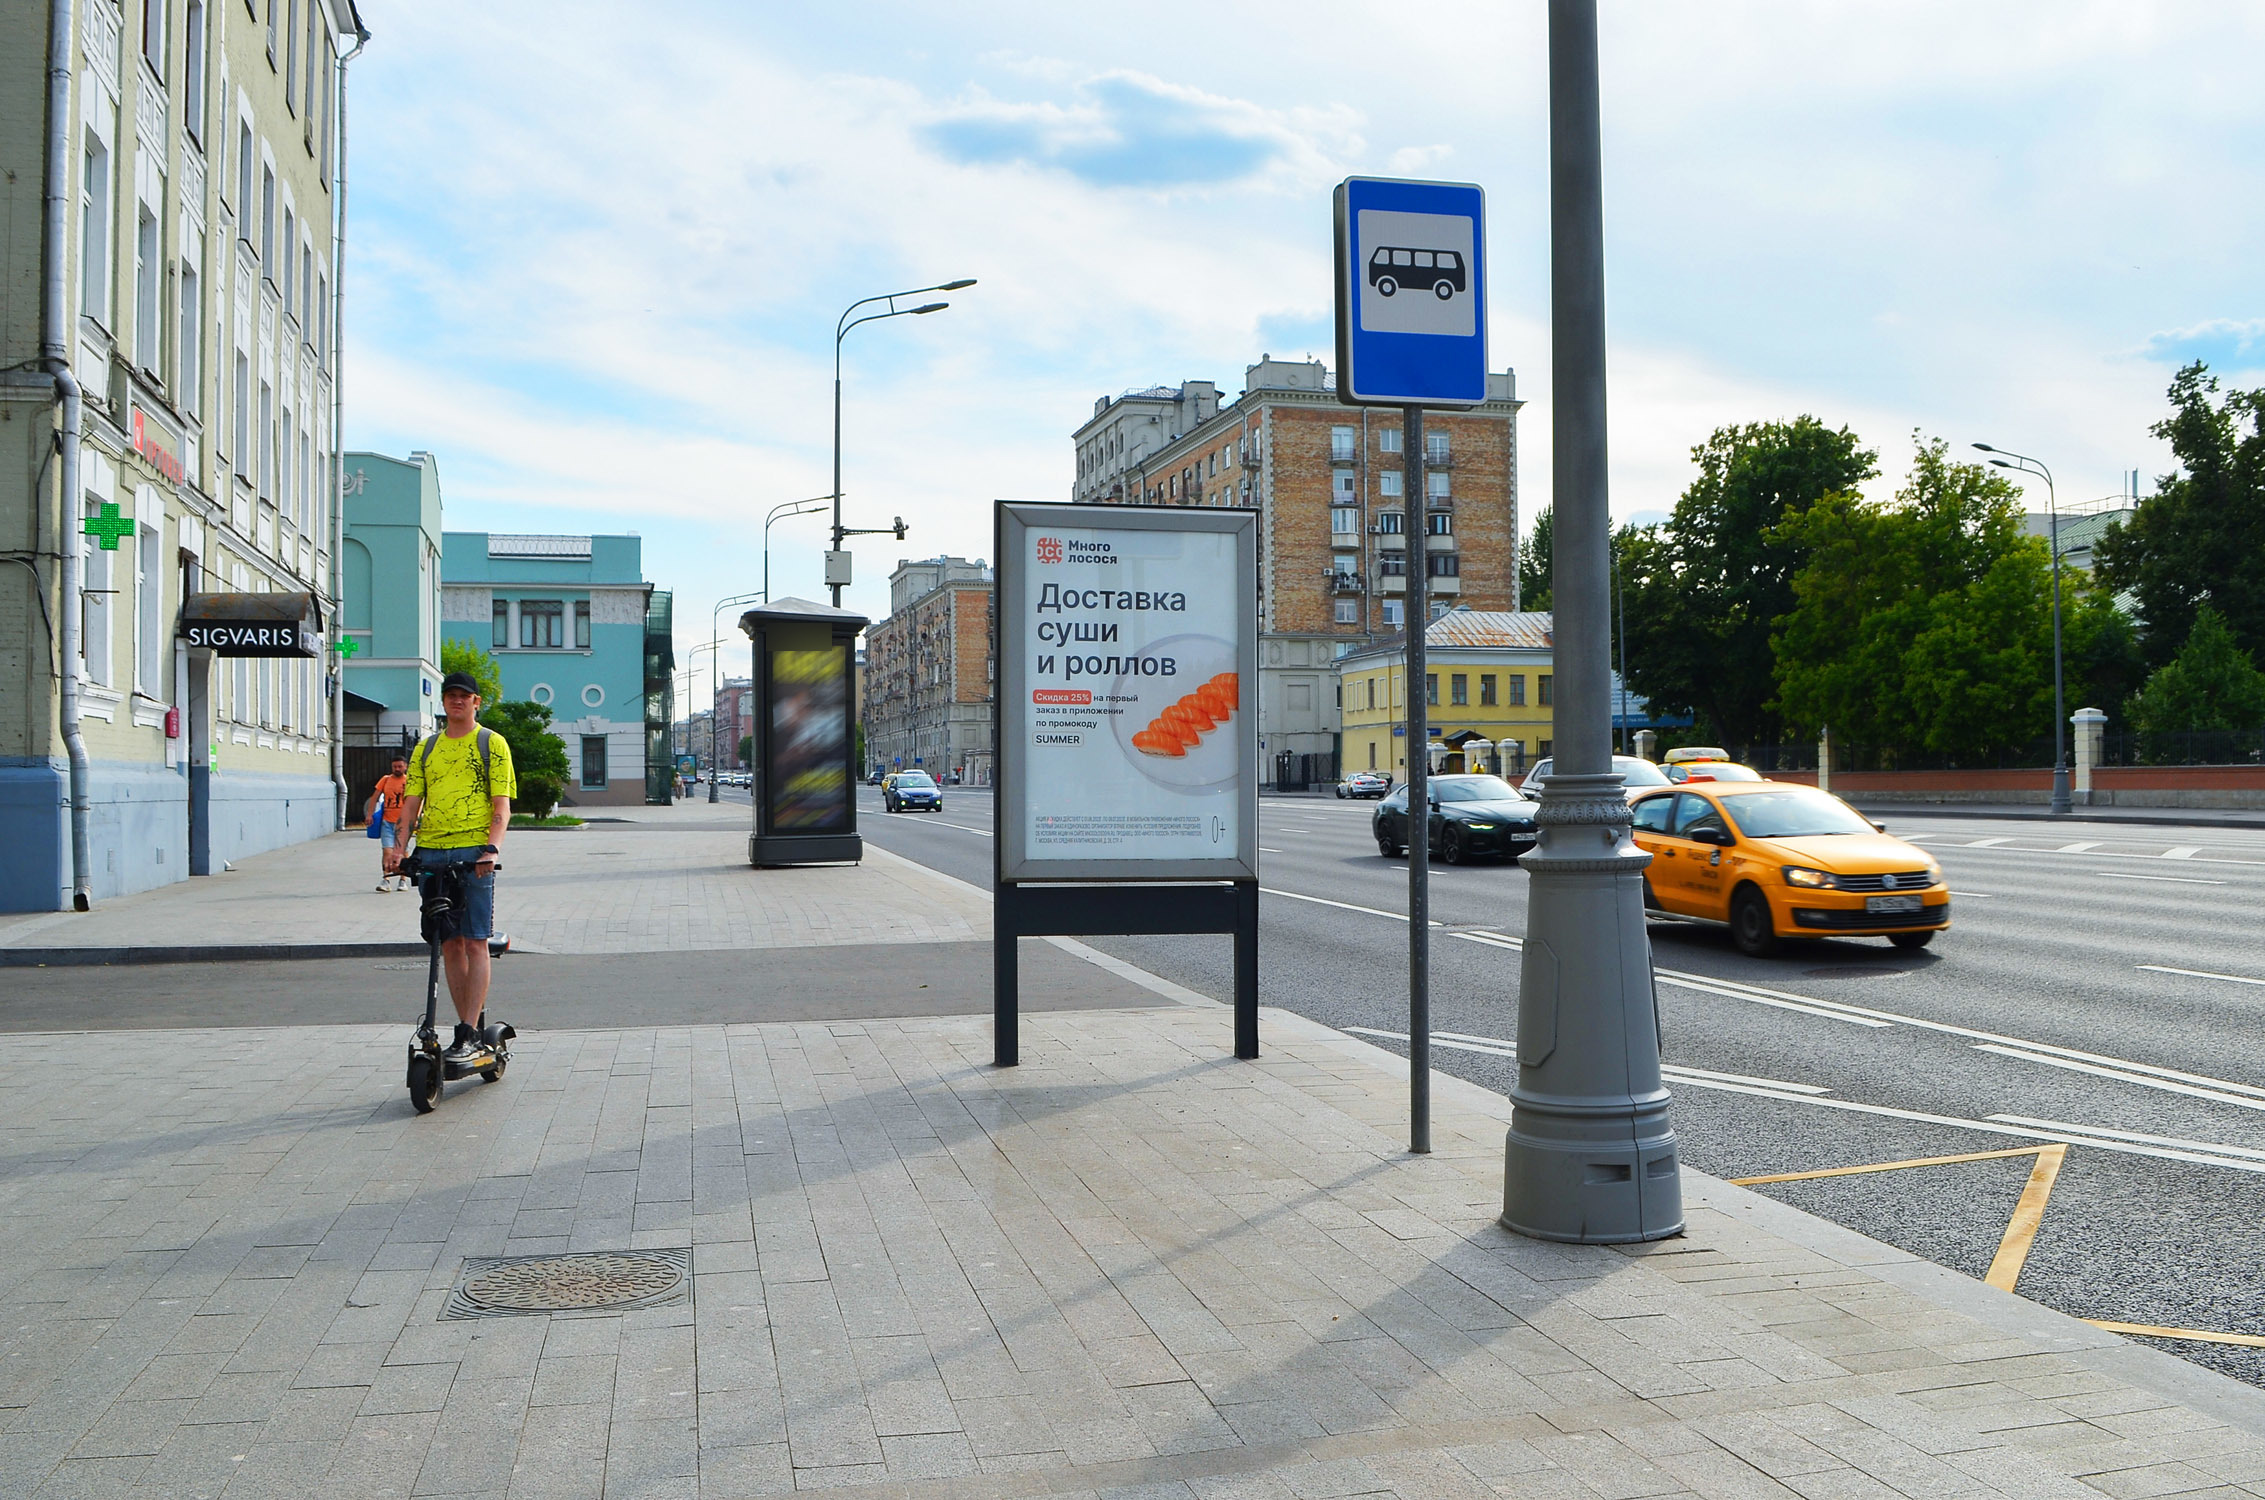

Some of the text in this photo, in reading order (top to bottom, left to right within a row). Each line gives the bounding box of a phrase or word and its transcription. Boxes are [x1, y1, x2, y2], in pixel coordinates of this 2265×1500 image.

[1068, 539, 1111, 552] Много
[1067, 554, 1118, 564] лосося
[1037, 583, 1186, 613] Доставка
[189, 628, 293, 646] SIGVARIS
[1037, 621, 1118, 648] суши
[1037, 655, 1177, 681] и роллов
[1035, 693, 1069, 703] Скидка
[1071, 693, 1089, 702] 25%
[1105, 694, 1139, 703] первый
[1069, 708, 1124, 716] приложении
[1048, 720, 1098, 729] промокоду
[1035, 735, 1080, 744] SUMMER
